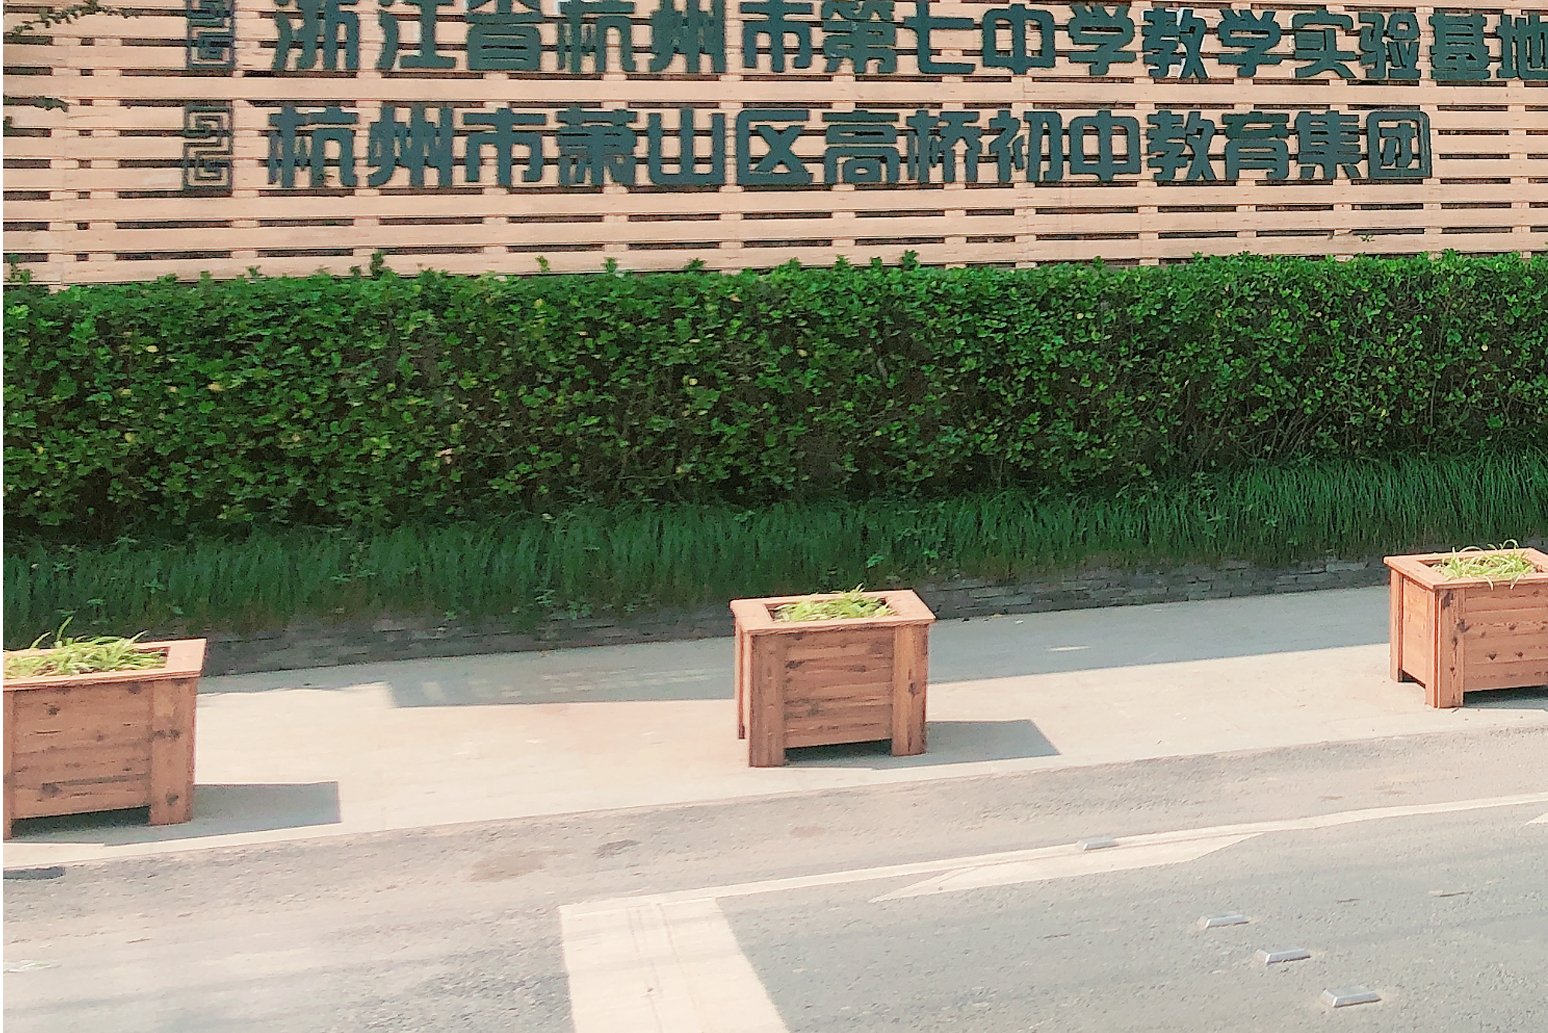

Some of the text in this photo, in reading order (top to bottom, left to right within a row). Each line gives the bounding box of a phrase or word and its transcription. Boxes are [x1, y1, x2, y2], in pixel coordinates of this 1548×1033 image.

[267, 103, 1432, 185] 杭州市萧山区高桥初中教育集团
